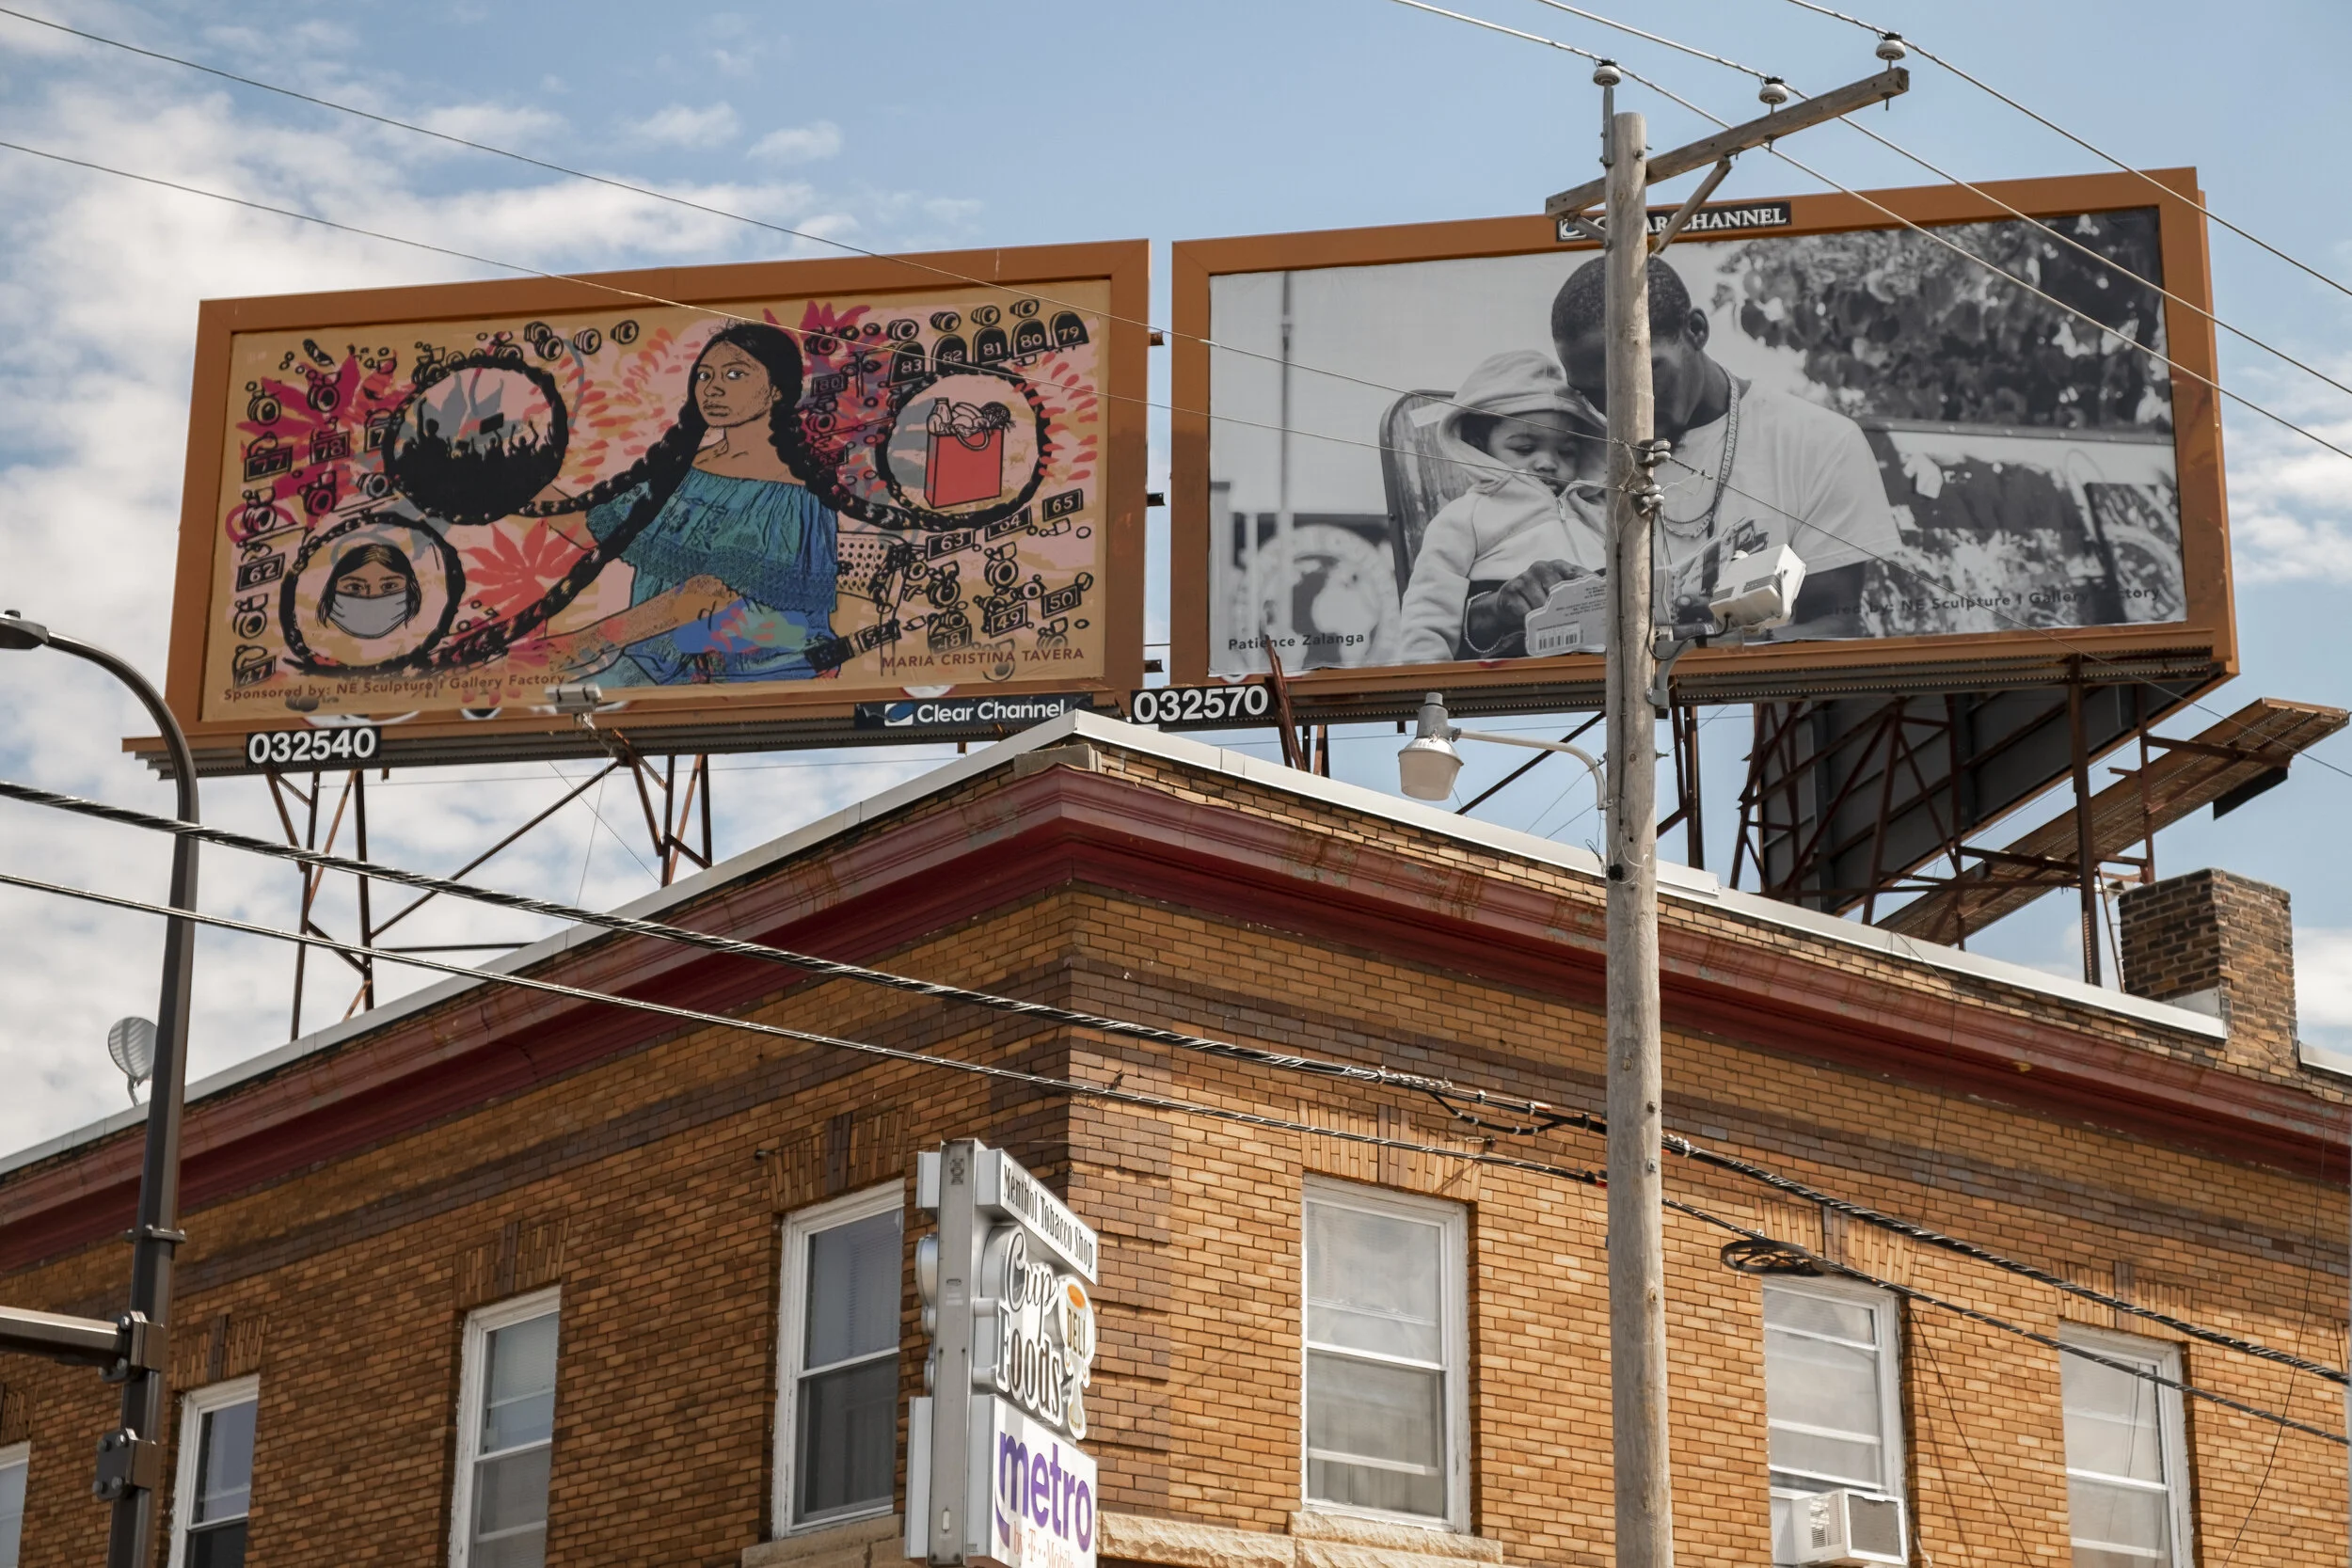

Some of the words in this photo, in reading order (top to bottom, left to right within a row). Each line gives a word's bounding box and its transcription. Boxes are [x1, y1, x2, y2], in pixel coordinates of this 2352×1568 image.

[1020, 333, 1042, 348] 80
[1057, 325, 1079, 341] 79
[942, 349, 963, 363] 82
[982, 341, 1002, 356] 81
[900, 358, 923, 374] 83
[320, 438, 344, 459] 78
[254, 453, 285, 472] 77
[1052, 495, 1073, 513] 65
[940, 532, 965, 551] 63
[248, 562, 276, 581] 62
[1049, 591, 1073, 610] 50
[1901, 599, 1925, 611] NE
[1931, 595, 2010, 610] Sculpture
[996, 610, 1020, 629] 49
[1302, 632, 1365, 647] Zalanga
[882, 656, 934, 670] MARIA
[941, 651, 1015, 666] CRISTINA
[1022, 648, 1085, 663] TAVERA
[224, 683, 304, 702] Sponsored
[309, 681, 330, 698] by:
[337, 682, 358, 694] NE
[364, 679, 433, 695] Sculpture
[450, 675, 502, 691] Gallery
[509, 673, 566, 689] Factory
[916, 701, 974, 725] Clear
[977, 698, 1066, 721] Channel
[1134, 685, 1268, 724] 032570
[248, 727, 376, 764] 032540
[1003, 1164, 1038, 1224] Menthol
[1040, 1196, 1073, 1253] Tobacco
[1074, 1226, 1093, 1274] Shop
[1008, 1232, 1057, 1347] Cup
[1067, 1307, 1087, 1359] DELI
[997, 1306, 1060, 1415] Foods
[995, 1430, 1092, 1554] metro
